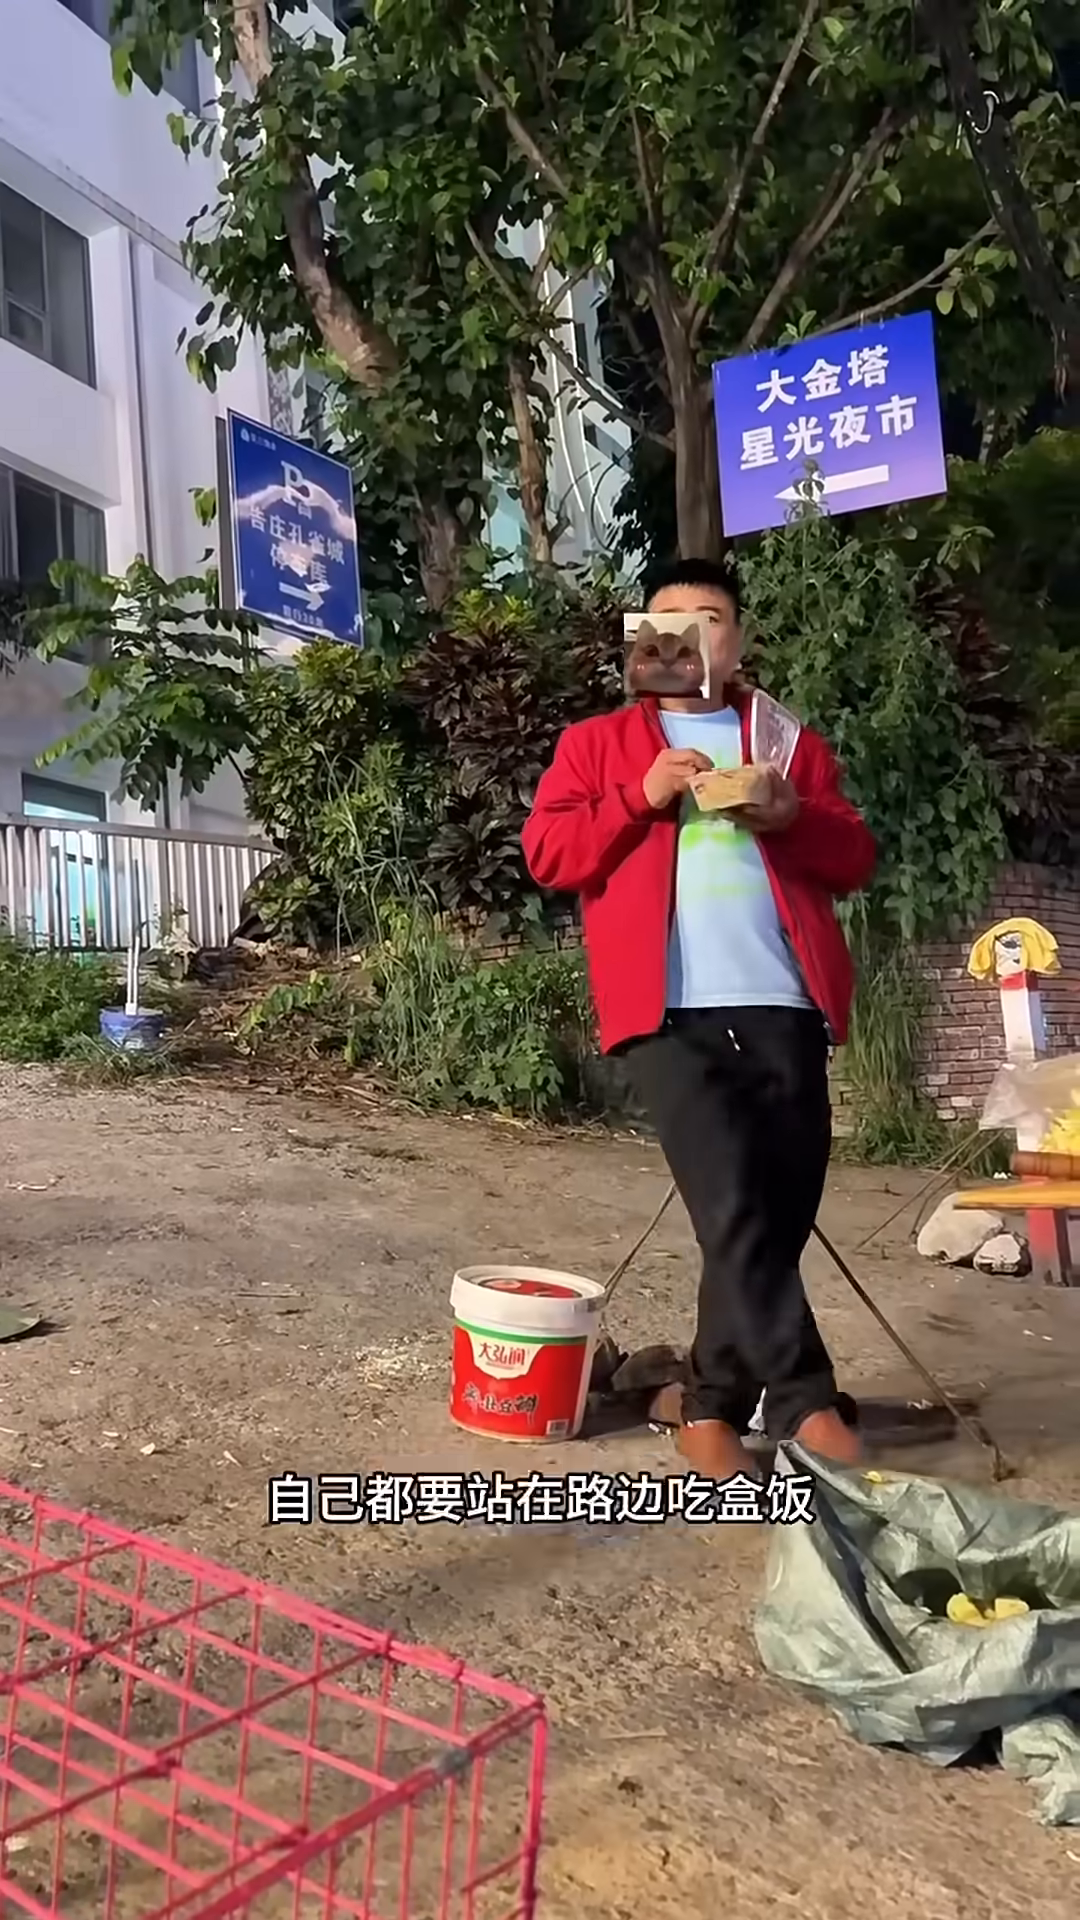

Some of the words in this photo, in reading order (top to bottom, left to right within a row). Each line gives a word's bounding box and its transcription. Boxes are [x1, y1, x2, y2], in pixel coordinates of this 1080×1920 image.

[756, 344, 890, 413] 大金塔
[740, 394, 918, 471] 星光夜市
[281, 460, 312, 508] P
